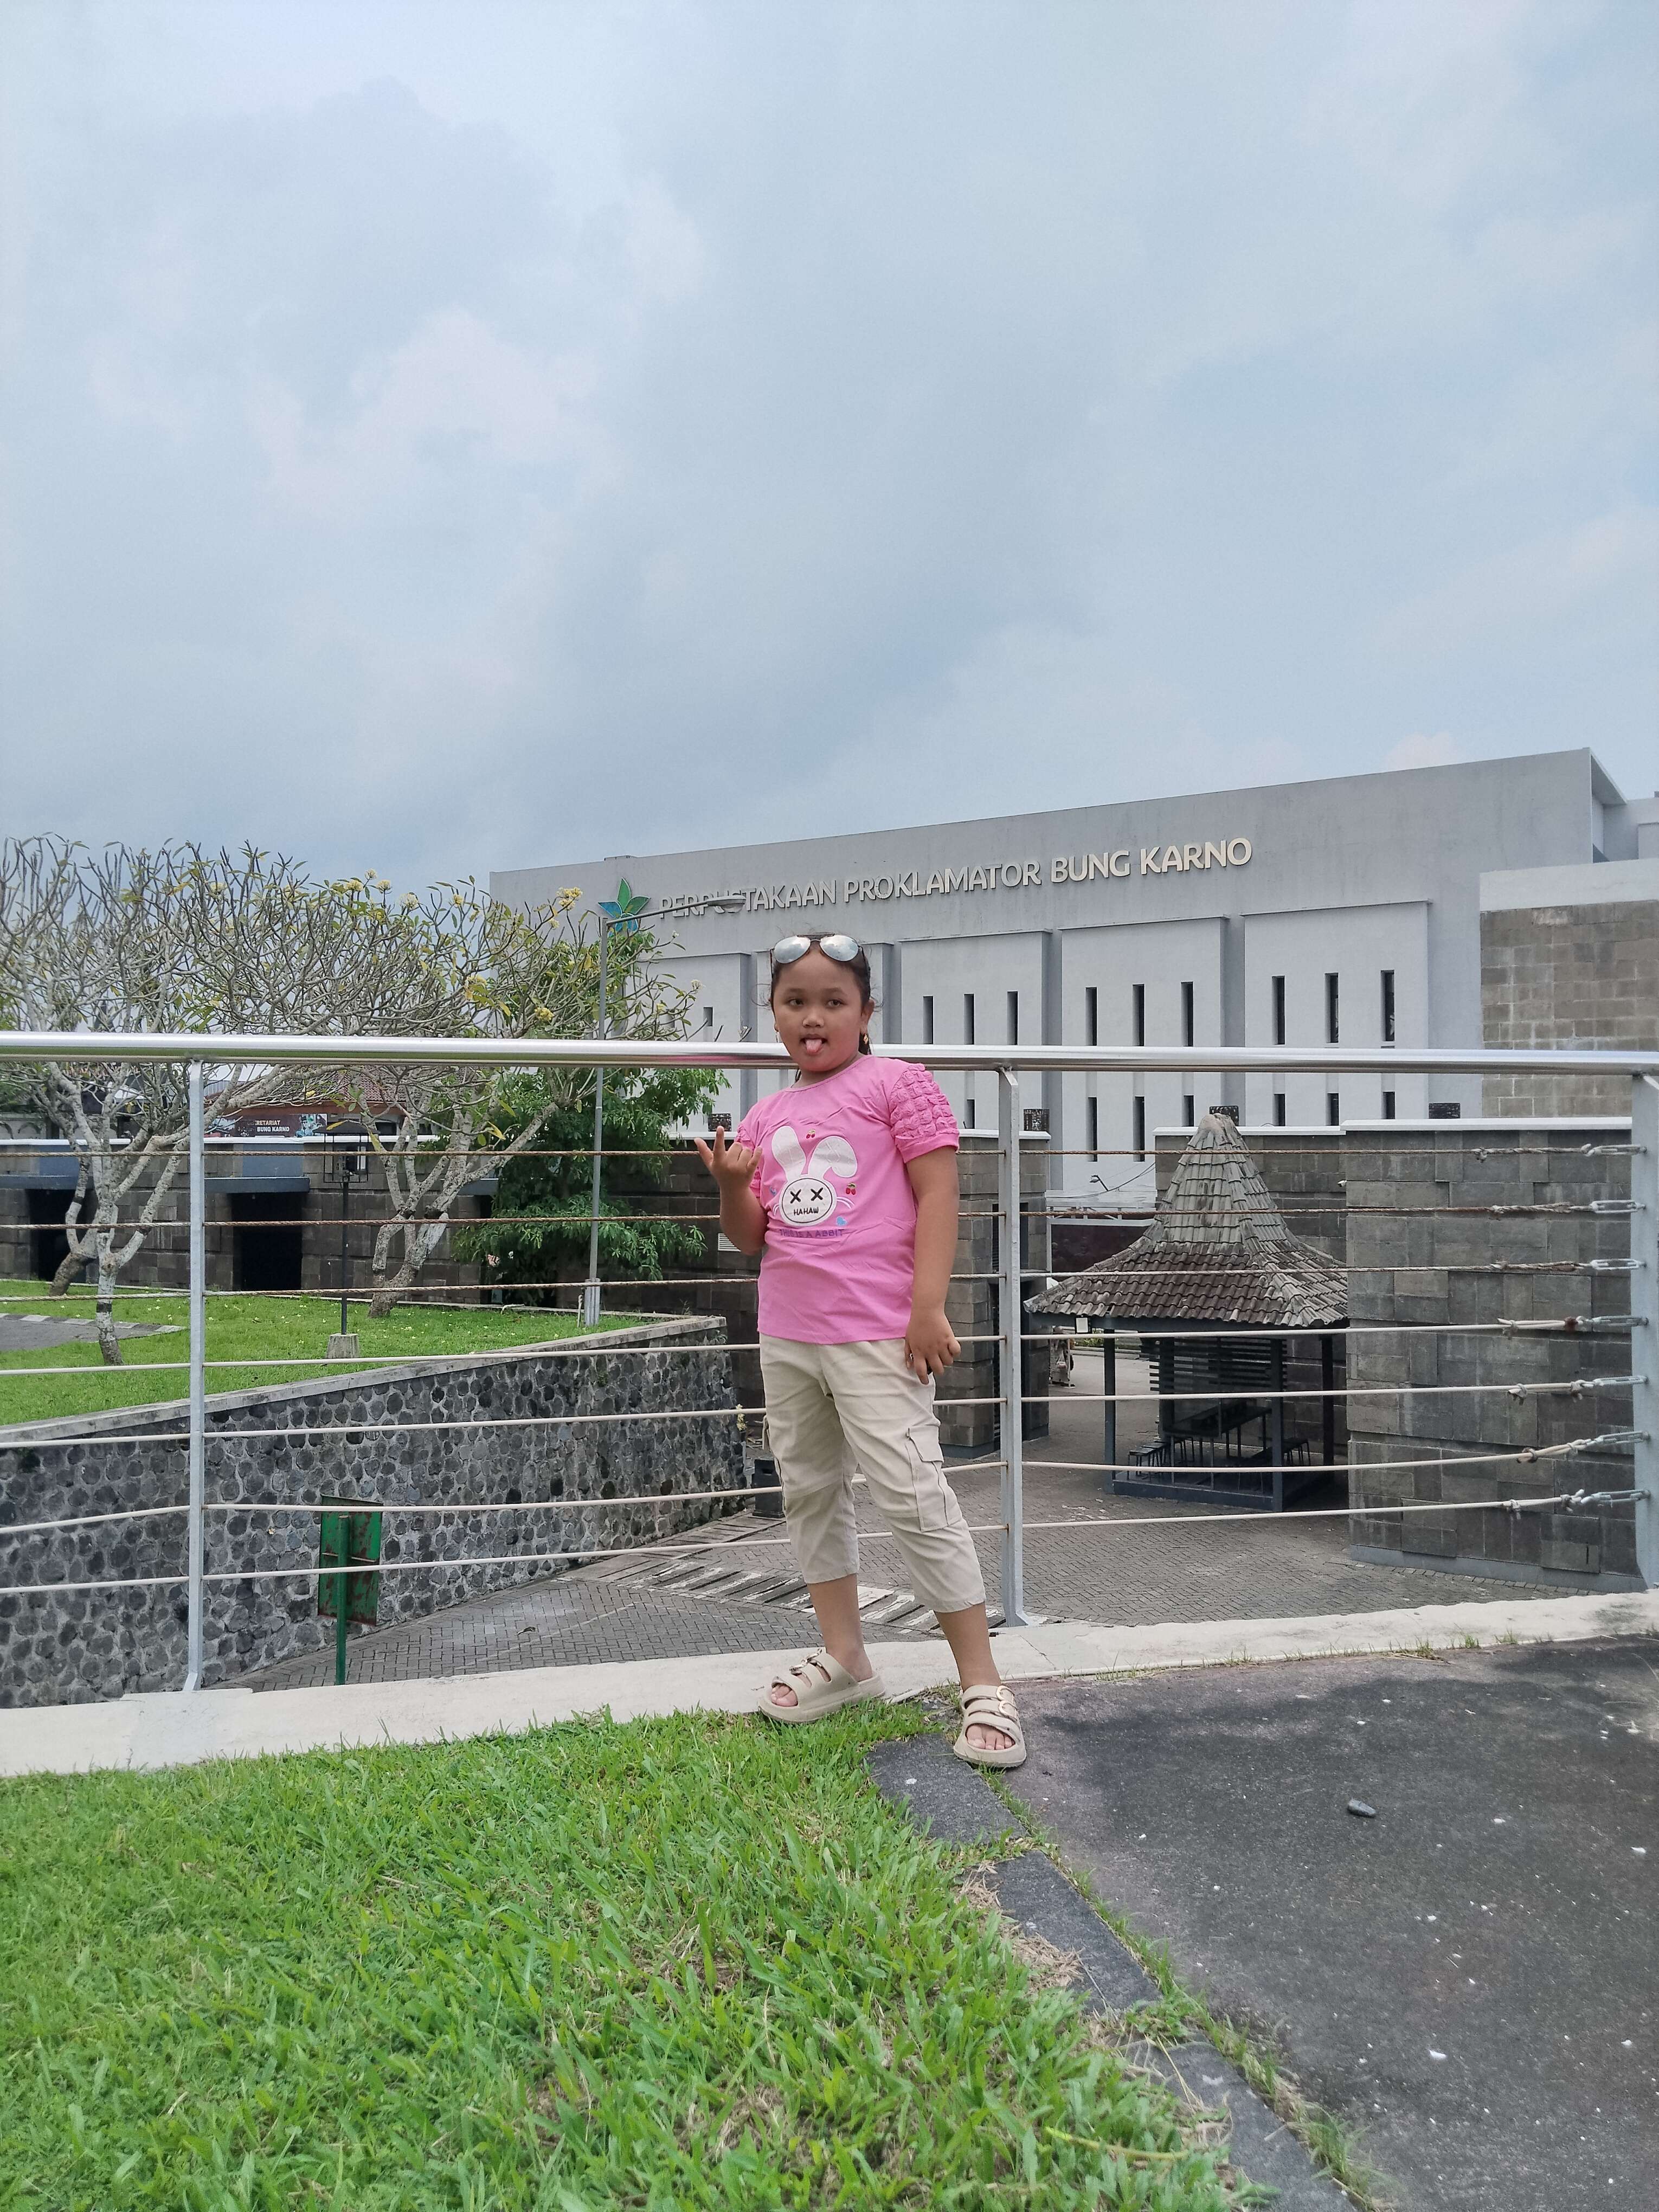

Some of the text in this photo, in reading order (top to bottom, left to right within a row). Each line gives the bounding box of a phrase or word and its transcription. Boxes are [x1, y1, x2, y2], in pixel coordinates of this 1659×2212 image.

[844, 861, 1042, 902] PROKLAMATOR
[1051, 850, 1131, 883] BUNG
[1140, 838, 1252, 875] KARNO
[794, 1207, 819, 1216] HAHAW
